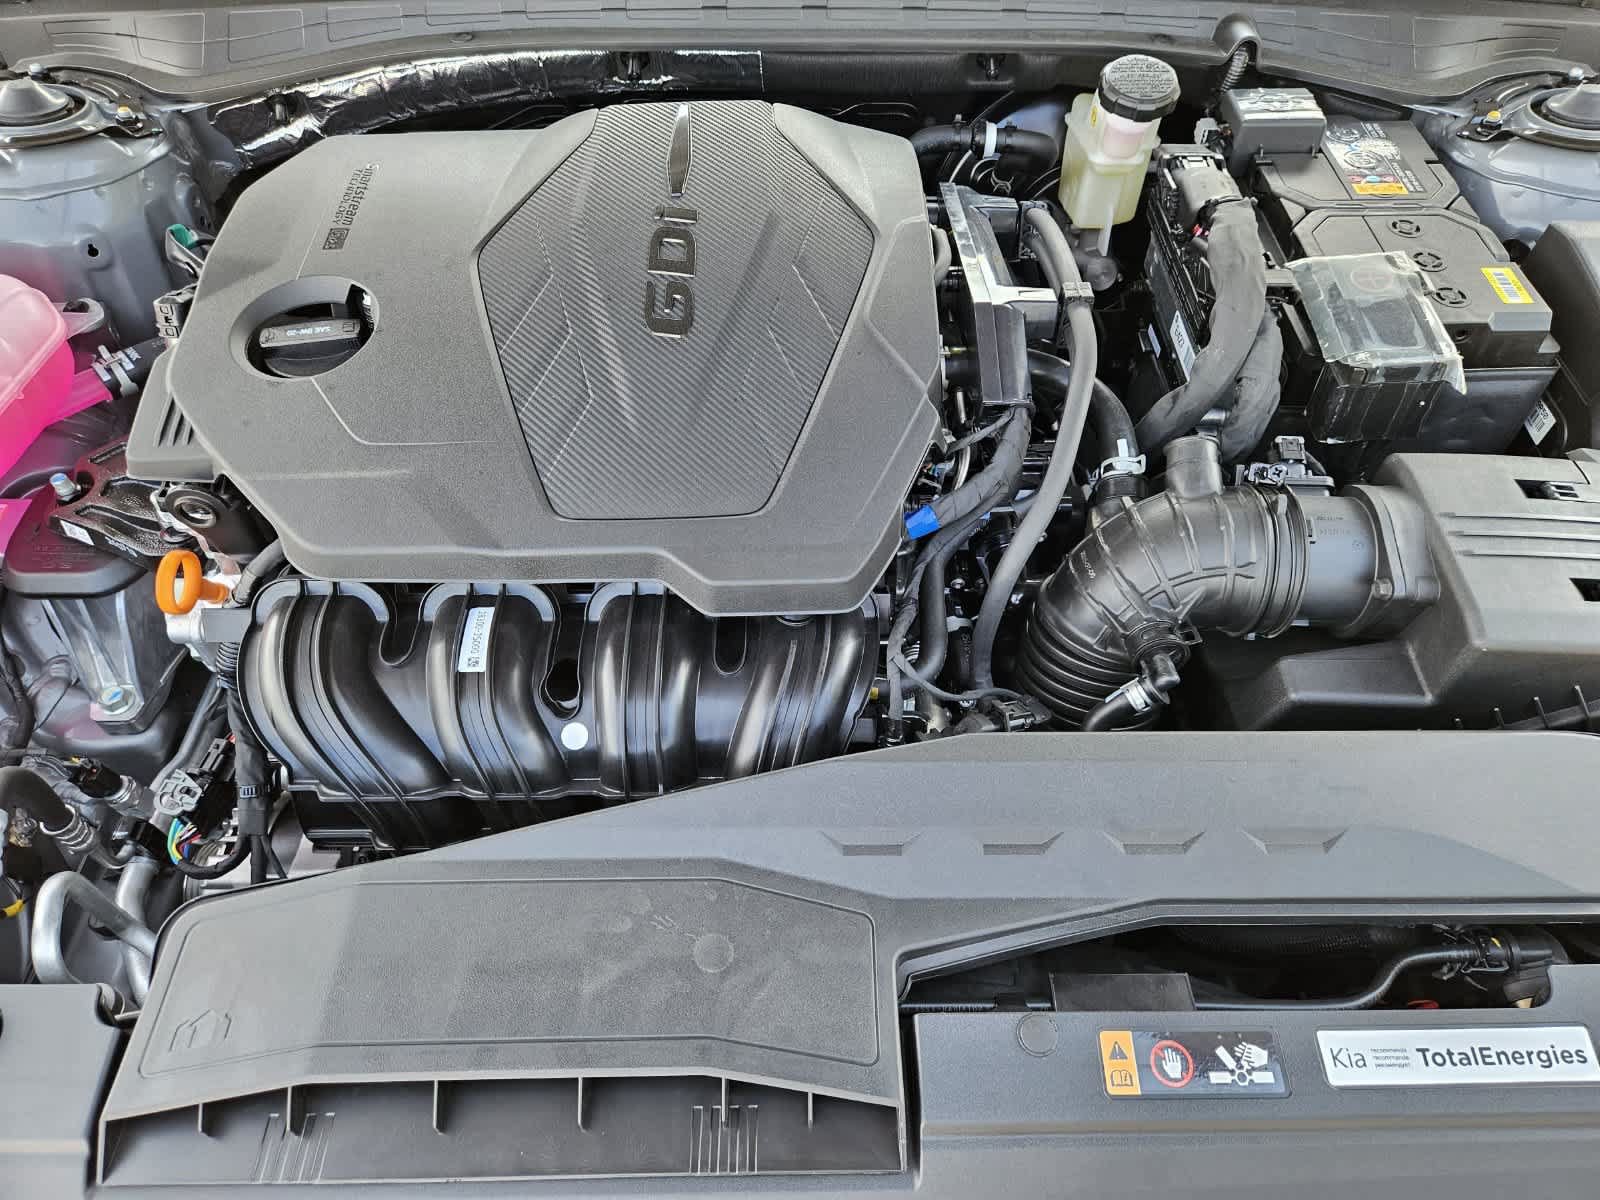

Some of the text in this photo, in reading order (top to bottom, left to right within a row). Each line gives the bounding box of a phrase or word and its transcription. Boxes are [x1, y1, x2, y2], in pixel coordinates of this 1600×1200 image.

[332, 169, 363, 225] TECHNOLOGY
[341, 164, 379, 226] Smartstream
[1330, 1047, 1367, 1069] Kia
[1415, 1045, 1588, 1069] TotalEnergies
